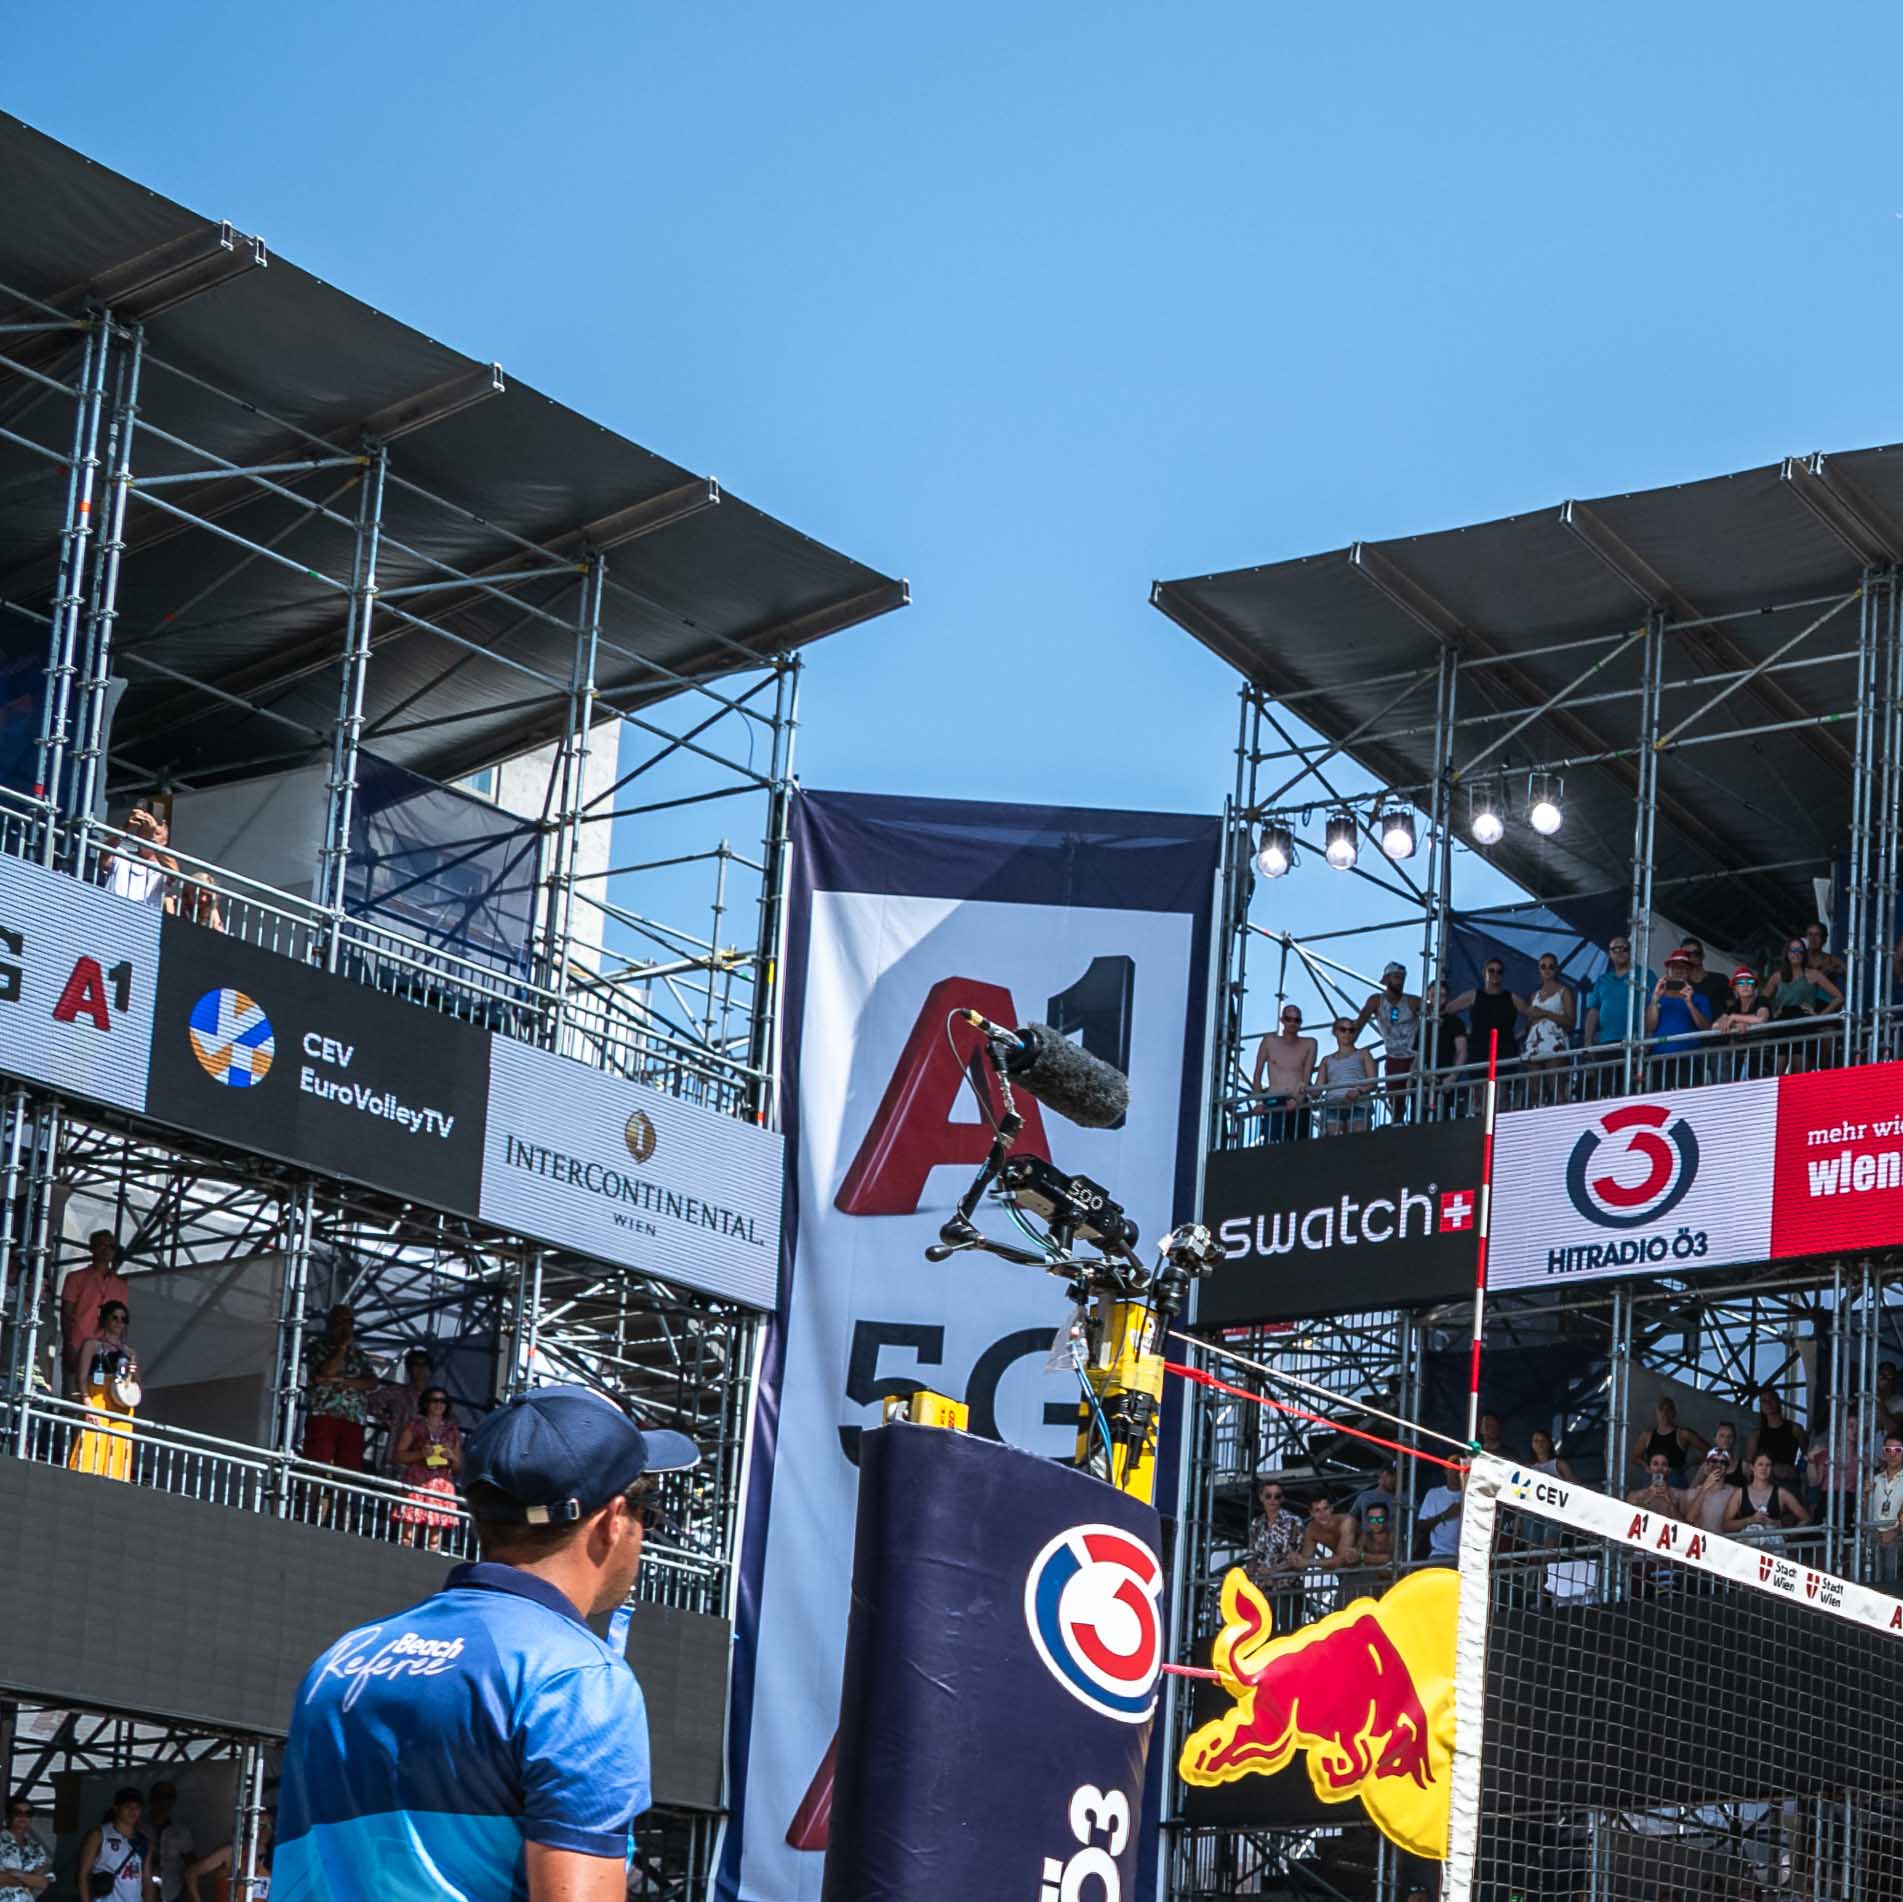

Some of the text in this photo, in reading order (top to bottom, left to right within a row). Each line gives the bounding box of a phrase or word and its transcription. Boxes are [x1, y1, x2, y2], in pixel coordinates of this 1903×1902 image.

[51, 954, 134, 1033] A1
[303, 1032, 355, 1067] CEV
[834, 955, 1135, 1217] A1
[301, 1066, 455, 1140] EuroVolleyTV
[1807, 1123, 1867, 1146] mehr
[613, 1213, 657, 1238] WIEN
[1219, 1187, 1433, 1261] swatch
[1547, 1228, 1709, 1274] HITRADIO Ö3
[1536, 1484, 1570, 1508] CEV
[1627, 1513, 1707, 1560] A1 A1 A1
[1772, 1573, 1796, 1593] Wien
[1775, 1560, 1798, 1578] Stadt
[1820, 1588, 1841, 1608] Wien
[1822, 1577, 1844, 1596] Stadt
[391, 1632, 465, 1661] Beach
[305, 1626, 458, 1713] Referee
